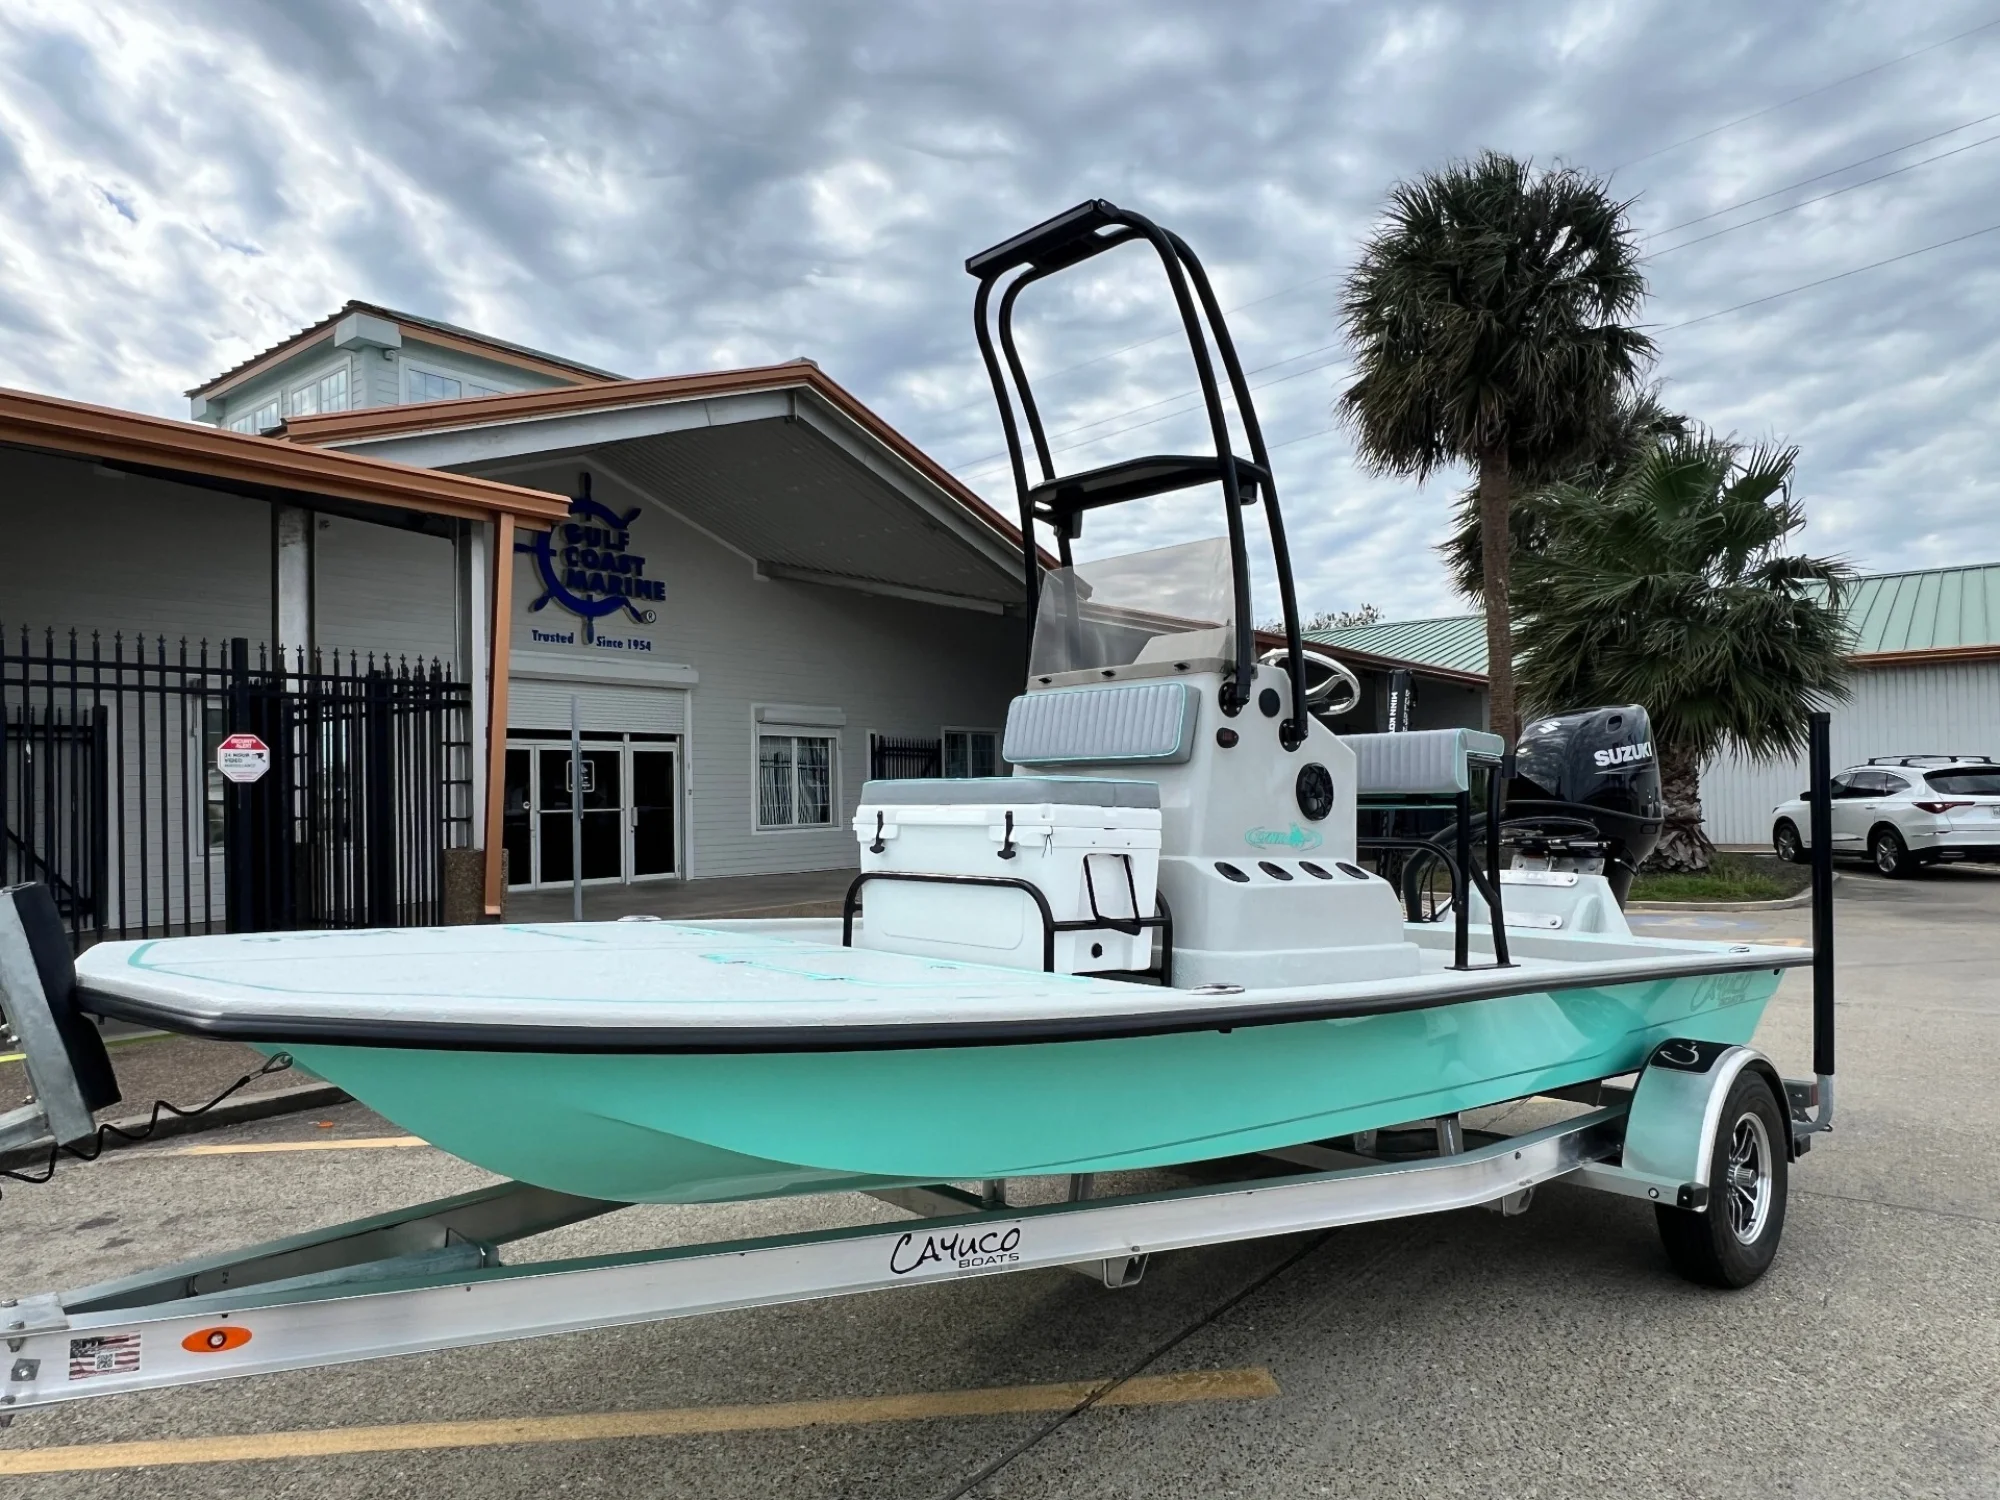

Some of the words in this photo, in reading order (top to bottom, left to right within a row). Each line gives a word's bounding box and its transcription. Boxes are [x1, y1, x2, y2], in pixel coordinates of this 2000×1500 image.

[564, 523, 630, 551] GULF
[564, 546, 646, 576] COAST
[565, 568, 666, 601] MARINE
[532, 629, 574, 645] Trusted
[596, 636, 623, 649] Since
[627, 638, 652, 652] 1954
[1389, 691, 1398, 717] MINN
[1594, 741, 1652, 767] SUZUKI
[890, 1228, 1020, 1274] CAYUCO
[958, 1252, 1020, 1268] BOATS
